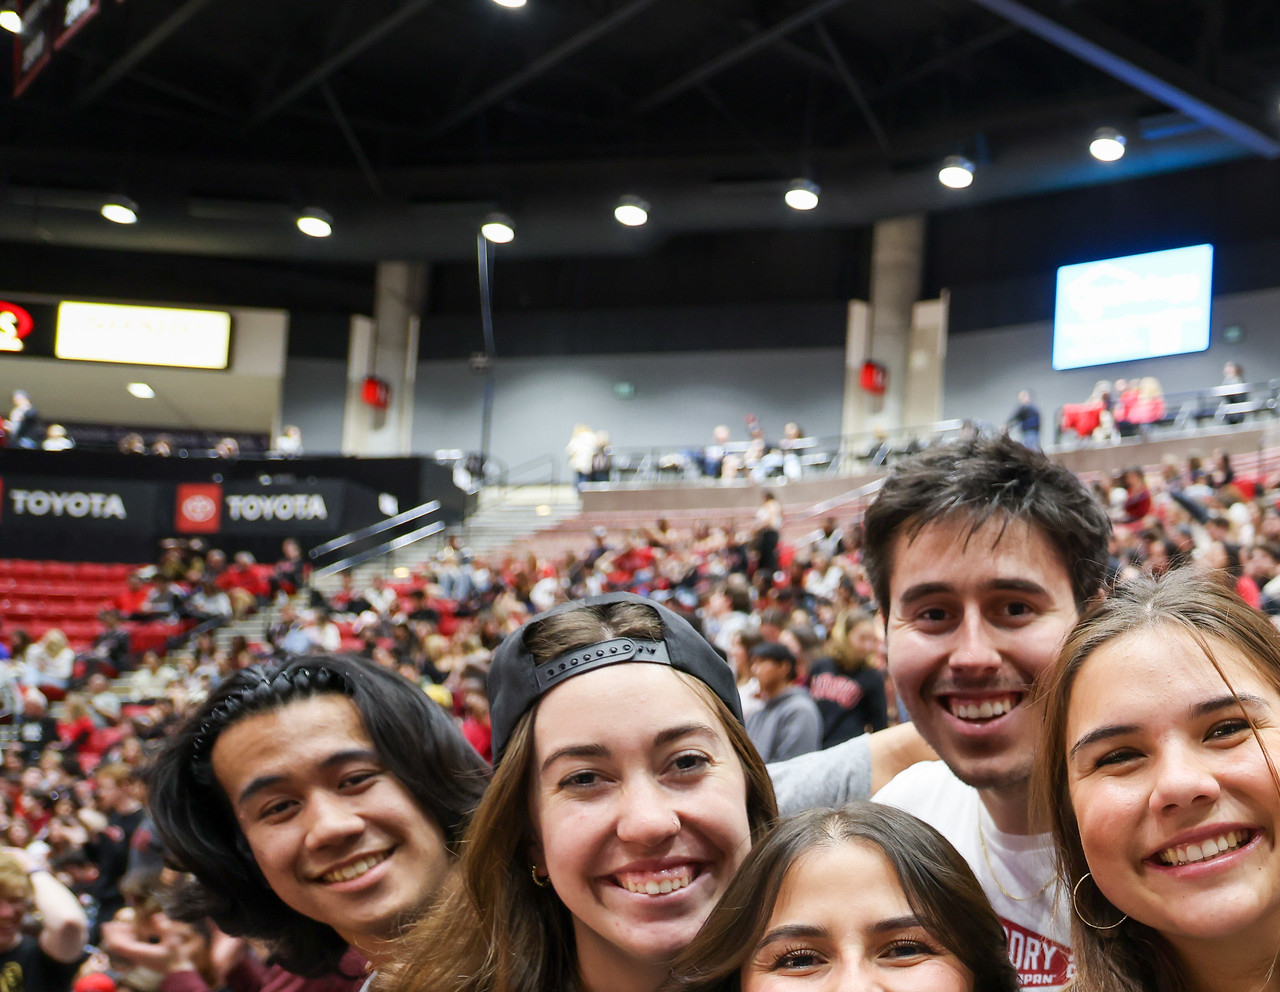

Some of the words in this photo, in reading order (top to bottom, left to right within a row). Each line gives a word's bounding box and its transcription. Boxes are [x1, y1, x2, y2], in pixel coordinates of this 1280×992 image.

[9, 488, 127, 520] TOYOTA
[225, 493, 328, 522] TOYOTA
[1003, 926, 1058, 971] DRY
